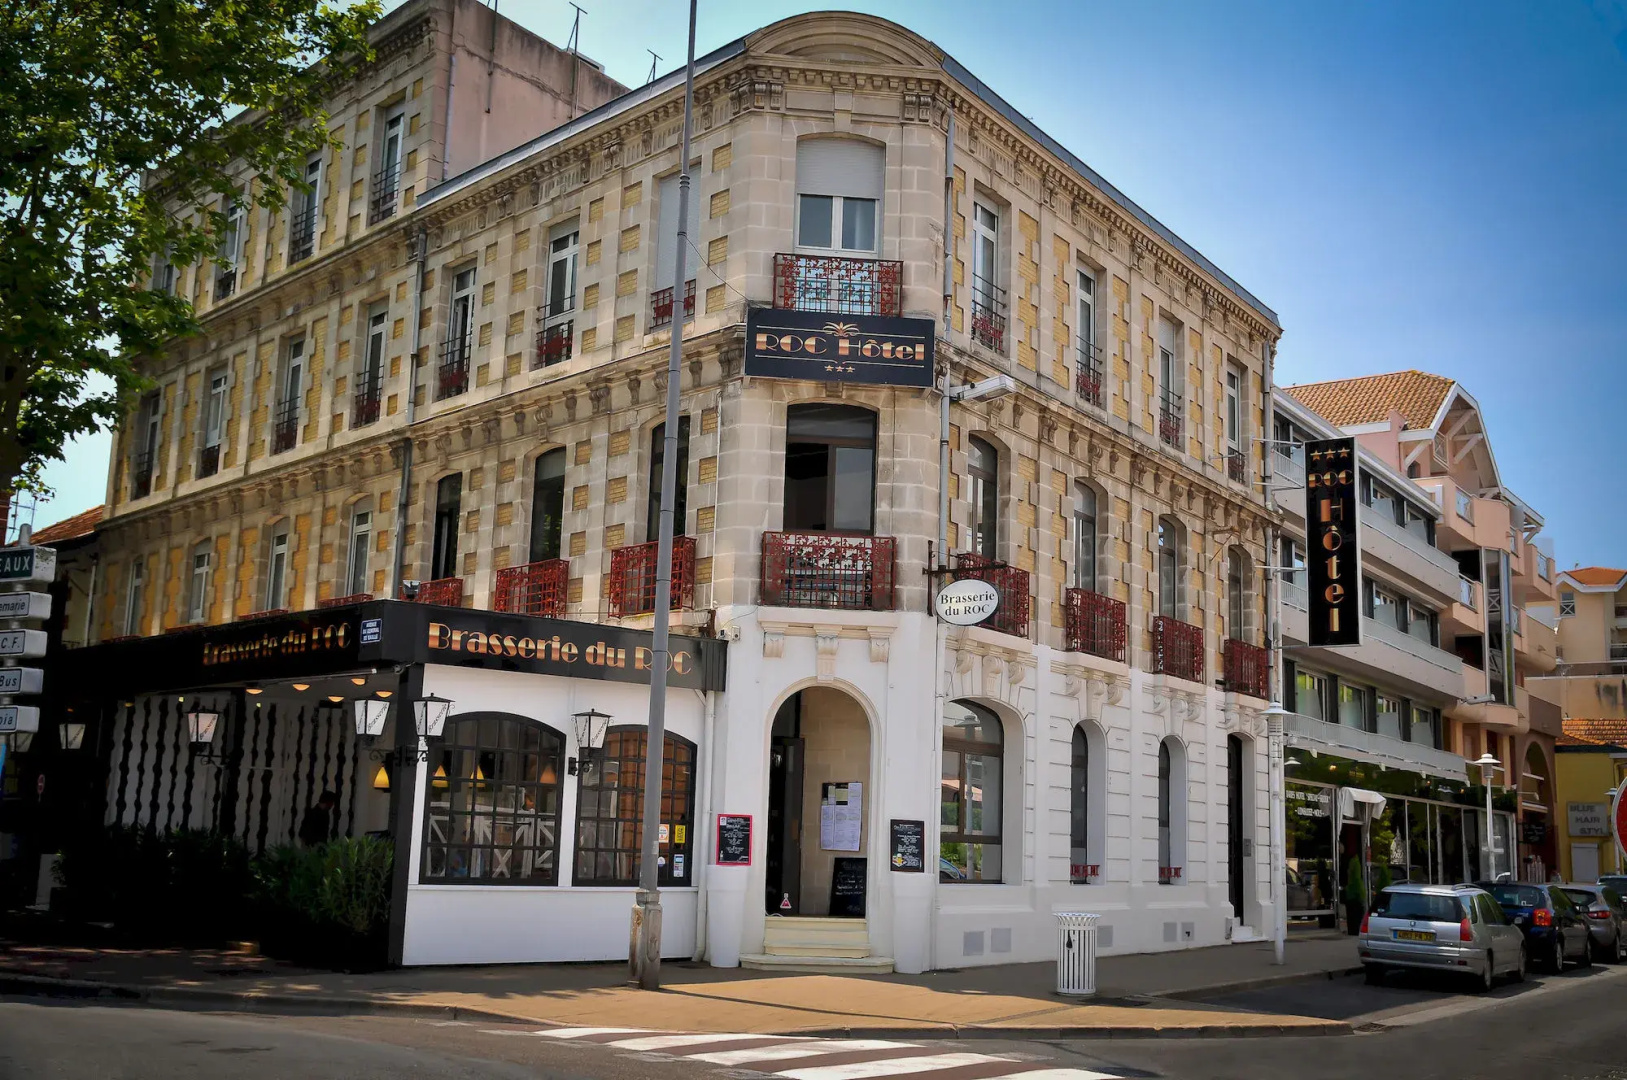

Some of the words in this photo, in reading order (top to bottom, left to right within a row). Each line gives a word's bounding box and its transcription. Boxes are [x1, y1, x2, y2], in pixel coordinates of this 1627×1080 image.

[756, 333, 827, 355] ROC
[838, 338, 925, 361] Hôtel
[1308, 469, 1353, 488] ROC
[0, 556, 31, 573] AUX
[1319, 497, 1345, 632] Hôtel
[940, 590, 995, 605] Brasserie
[944, 605, 960, 617] du
[963, 604, 990, 615] ROC
[280, 629, 307, 655] du
[428, 622, 579, 664] Brasserie
[585, 641, 626, 669] du
[634, 646, 692, 675] RC
[1575, 816, 1601, 824] HAIR
